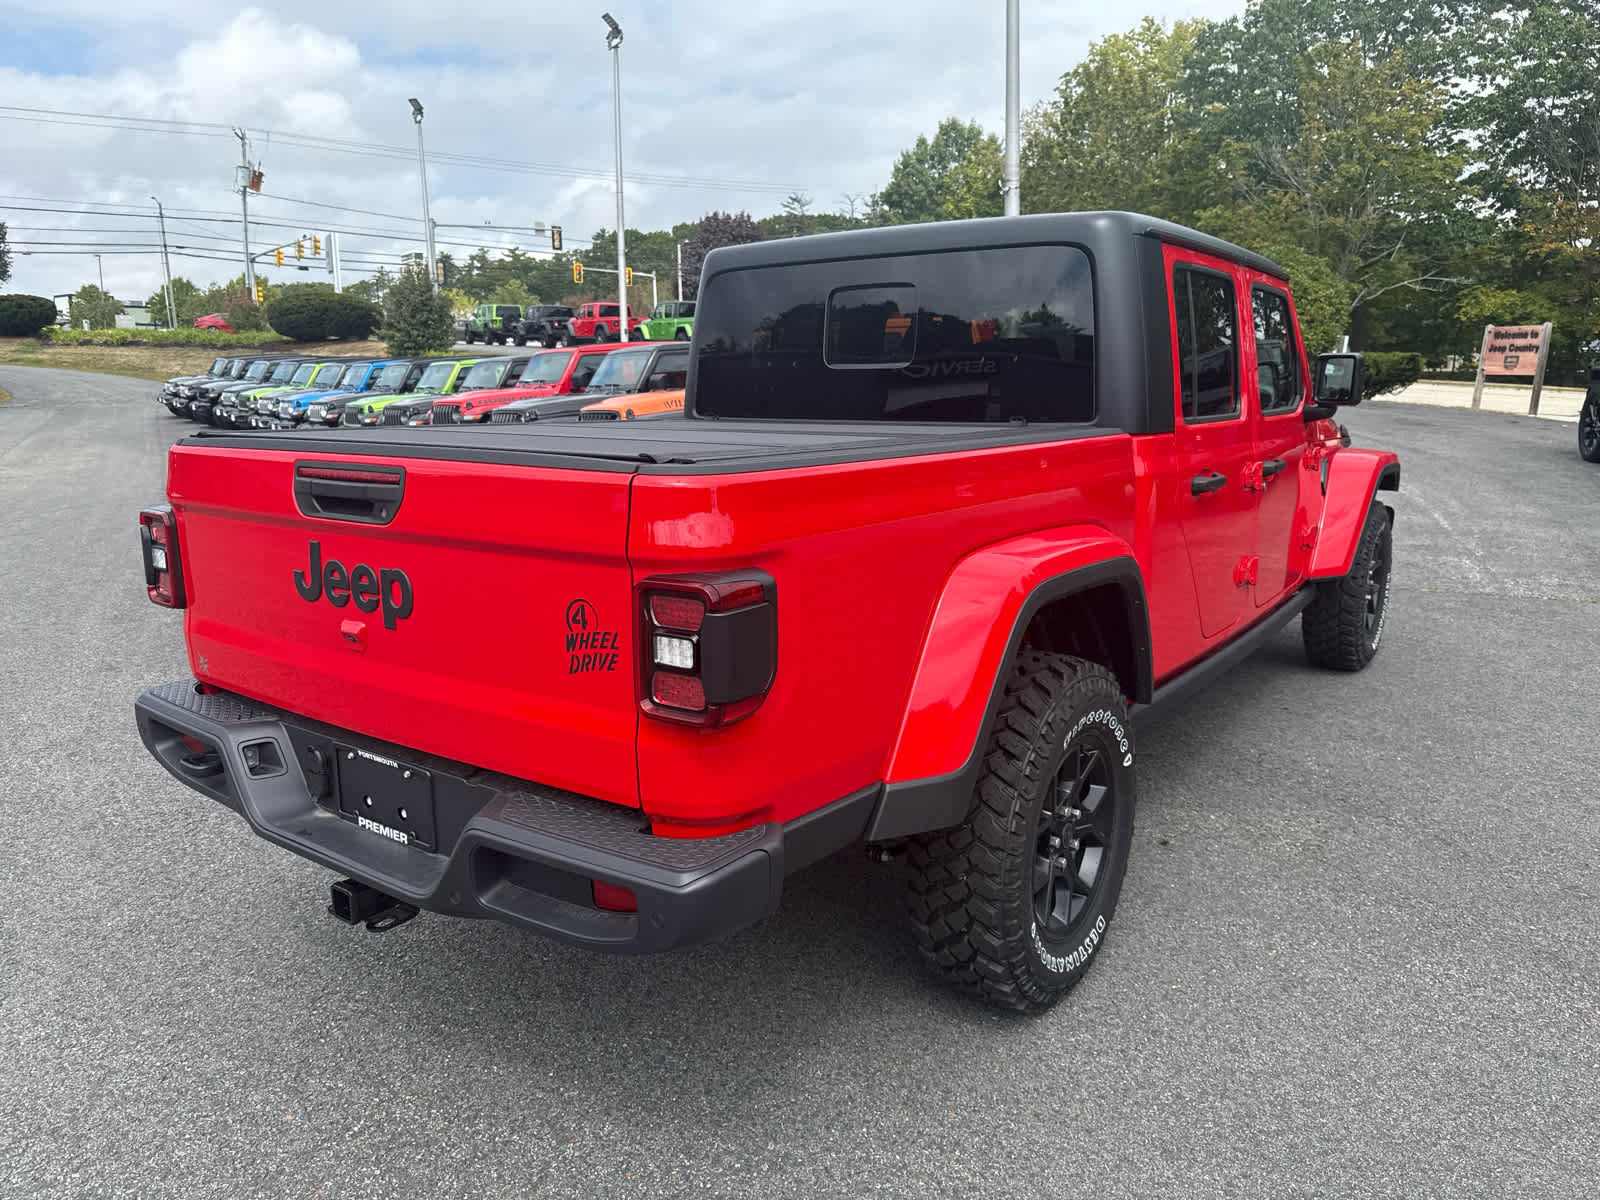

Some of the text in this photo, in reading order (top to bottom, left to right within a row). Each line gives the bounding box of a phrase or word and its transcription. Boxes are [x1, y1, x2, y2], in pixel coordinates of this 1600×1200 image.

[1494, 329, 1539, 340] Welcome to
[1488, 344, 1540, 354] Jeep Country
[294, 540, 413, 630] Jeep
[571, 604, 587, 630] 4
[565, 632, 619, 651] WHEEL
[569, 653, 619, 674] DRIVE
[358, 816, 409, 845] PREMIER
